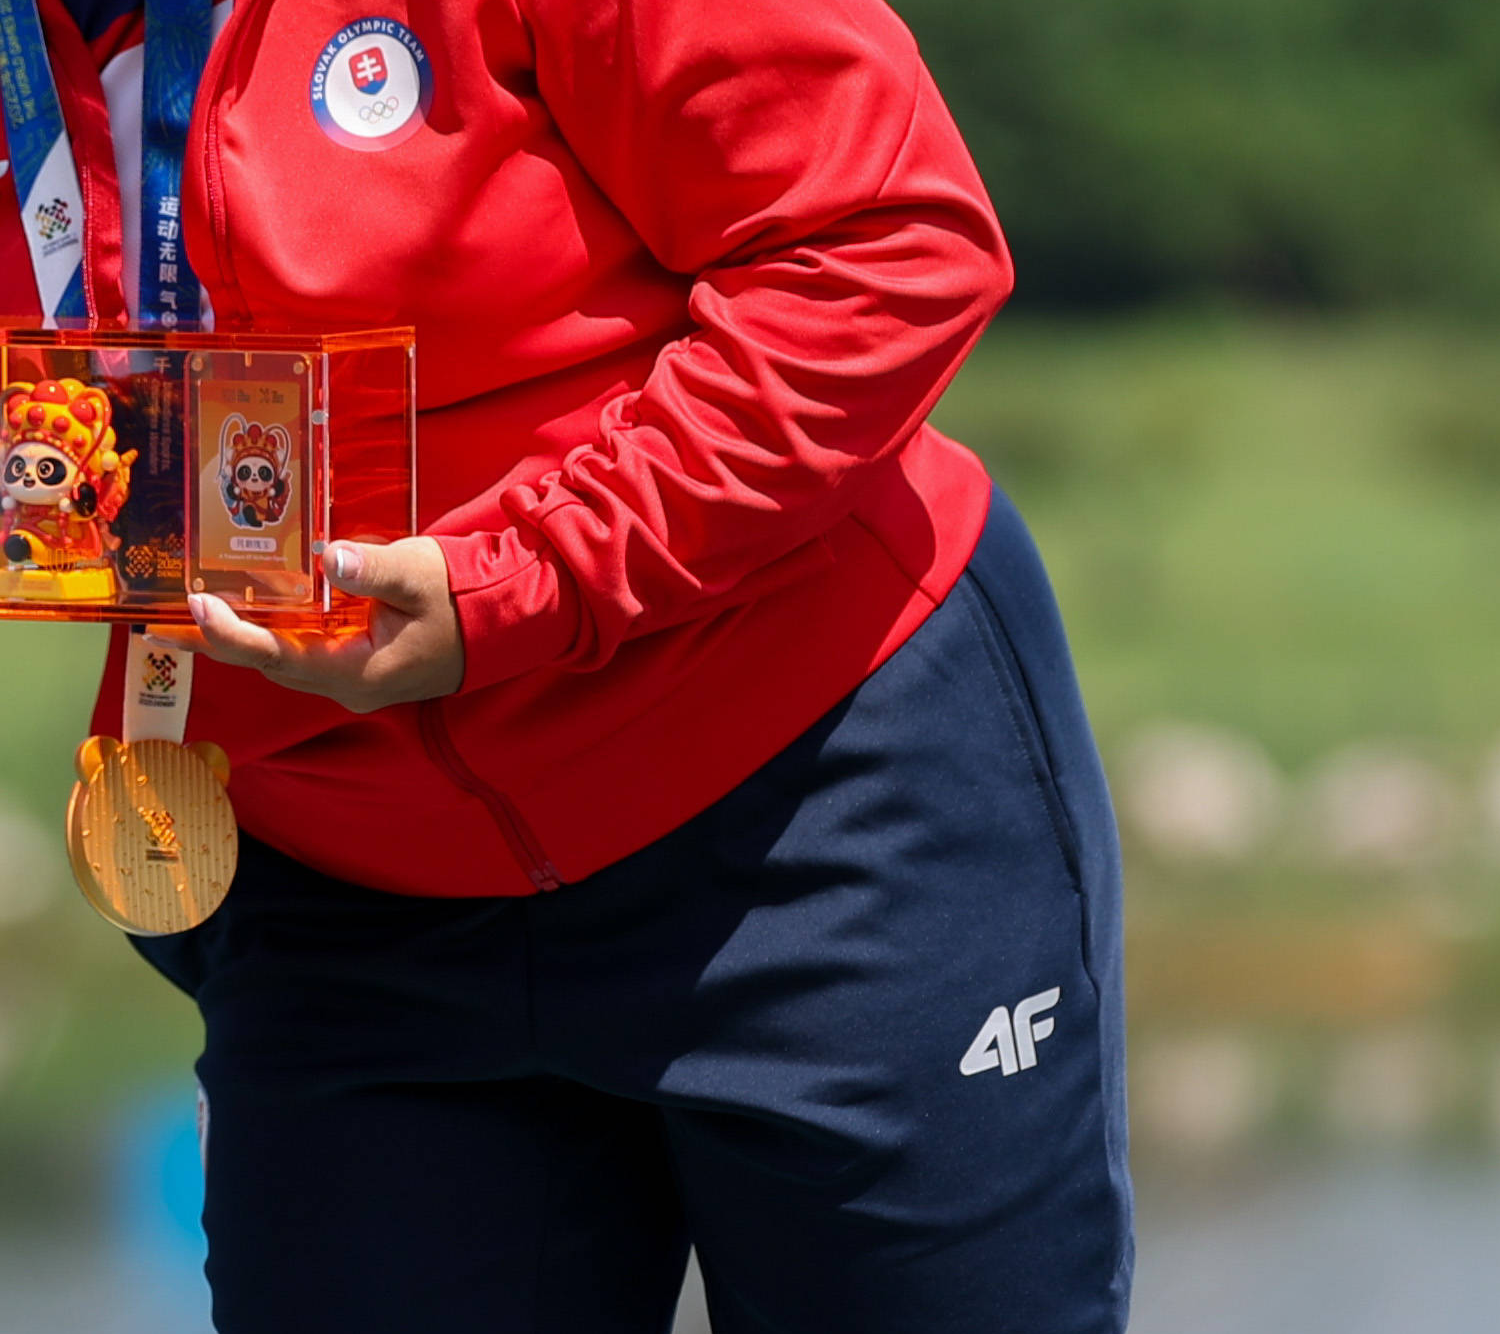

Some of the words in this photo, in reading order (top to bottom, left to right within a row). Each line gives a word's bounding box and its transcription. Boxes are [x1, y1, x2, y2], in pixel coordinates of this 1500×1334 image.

[312, 43, 337, 101] SLOVAK
[337, 19, 395, 44] OLYMPIC
[398, 28, 425, 62] TEAM
[157, 195, 179, 284] 运动无限
[959, 986, 1061, 1077] 4F
